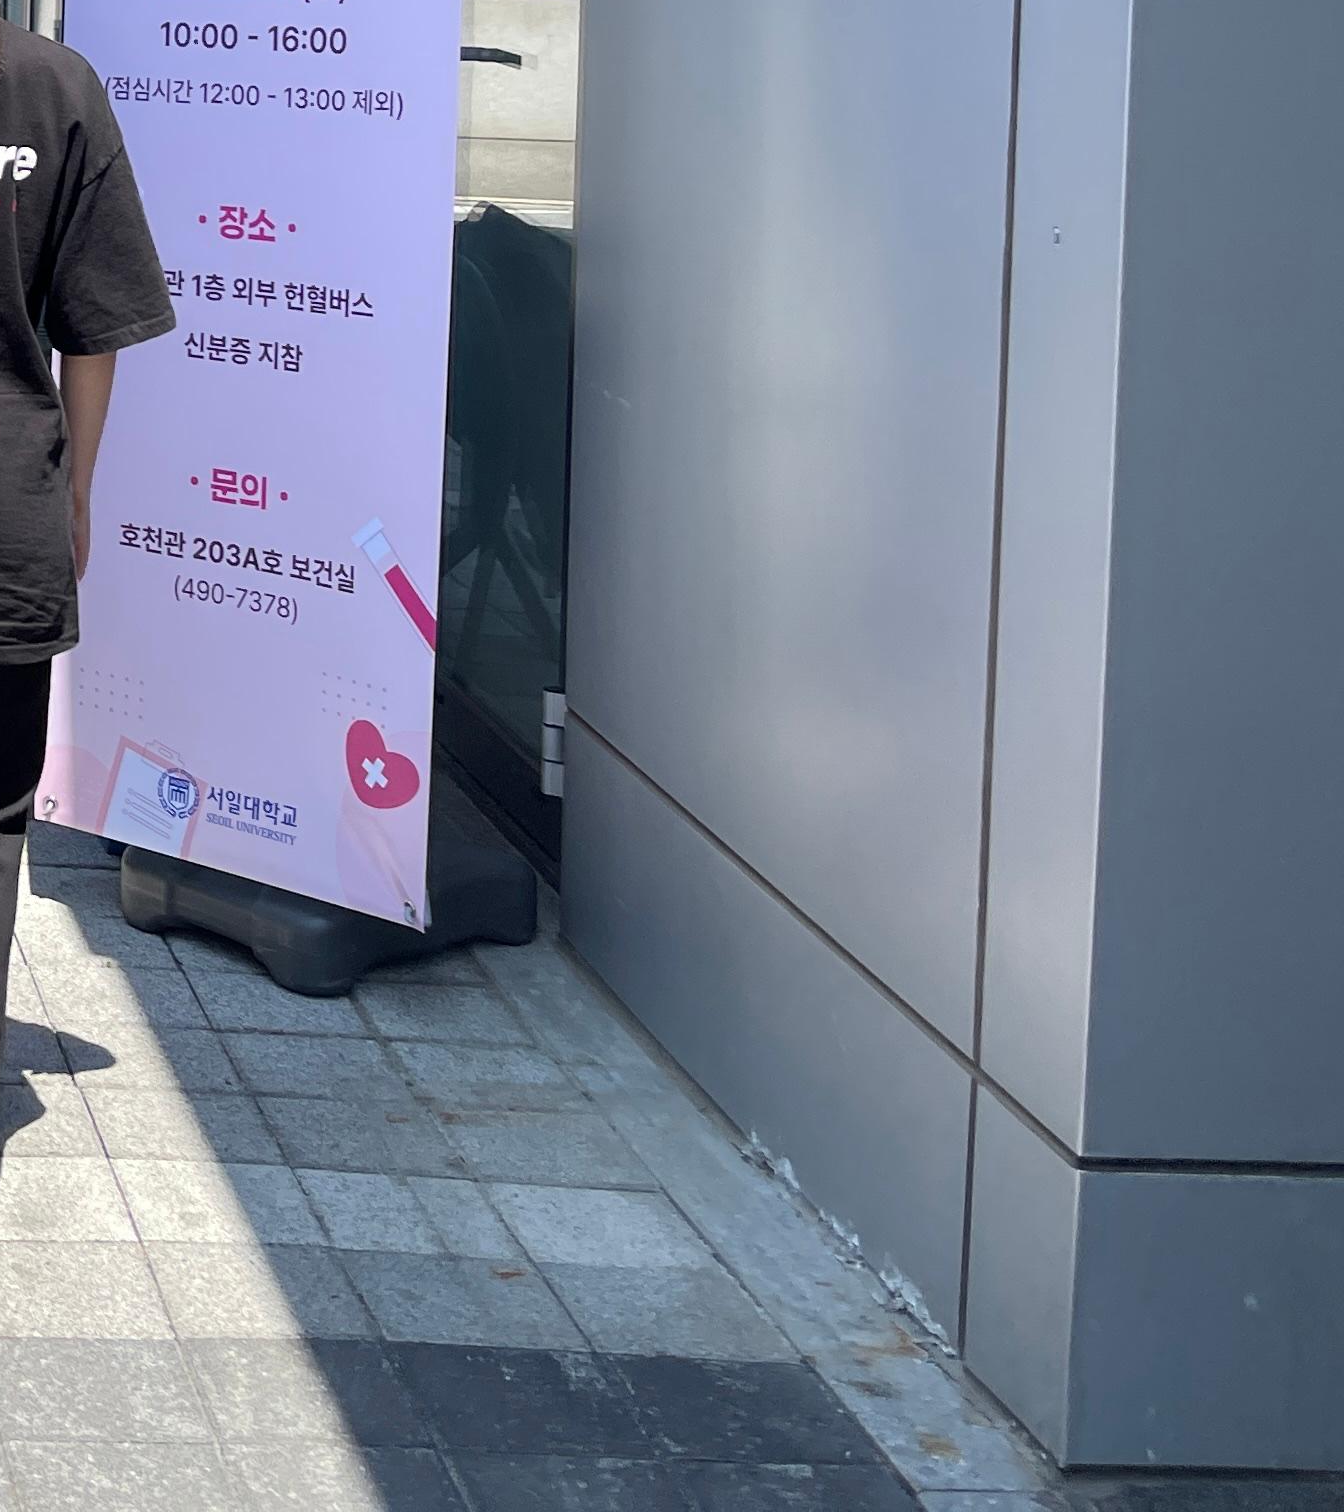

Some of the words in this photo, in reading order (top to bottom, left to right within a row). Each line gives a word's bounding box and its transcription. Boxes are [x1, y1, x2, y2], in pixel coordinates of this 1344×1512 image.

[160, 22, 238, 50] 10:00
[268, 25, 347, 55] 16:00
[105, 75, 194, 105] (점심시간
[199, 82, 260, 106] 12:00
[284, 87, 346, 112] 13:00
[351, 89, 404, 121] 제외)
[218, 205, 276, 243] 장소
[192, 273, 226, 301] 1층
[232, 277, 278, 308] 외부
[284, 282, 374, 318] 헌혈버스
[183, 332, 252, 366] 신분증
[258, 341, 304, 373] 지참
[210, 468, 268, 510] 문의
[119, 522, 186, 557] 호천관
[192, 536, 284, 575] 203A호
[289, 554, 355, 595] 보건실
[174, 579, 299, 625] (490-7378)
[207, 786, 298, 828] 서일대학교
[205, 812, 235, 829] SEOIL
[236, 820, 297, 846] UNIVERSITY
